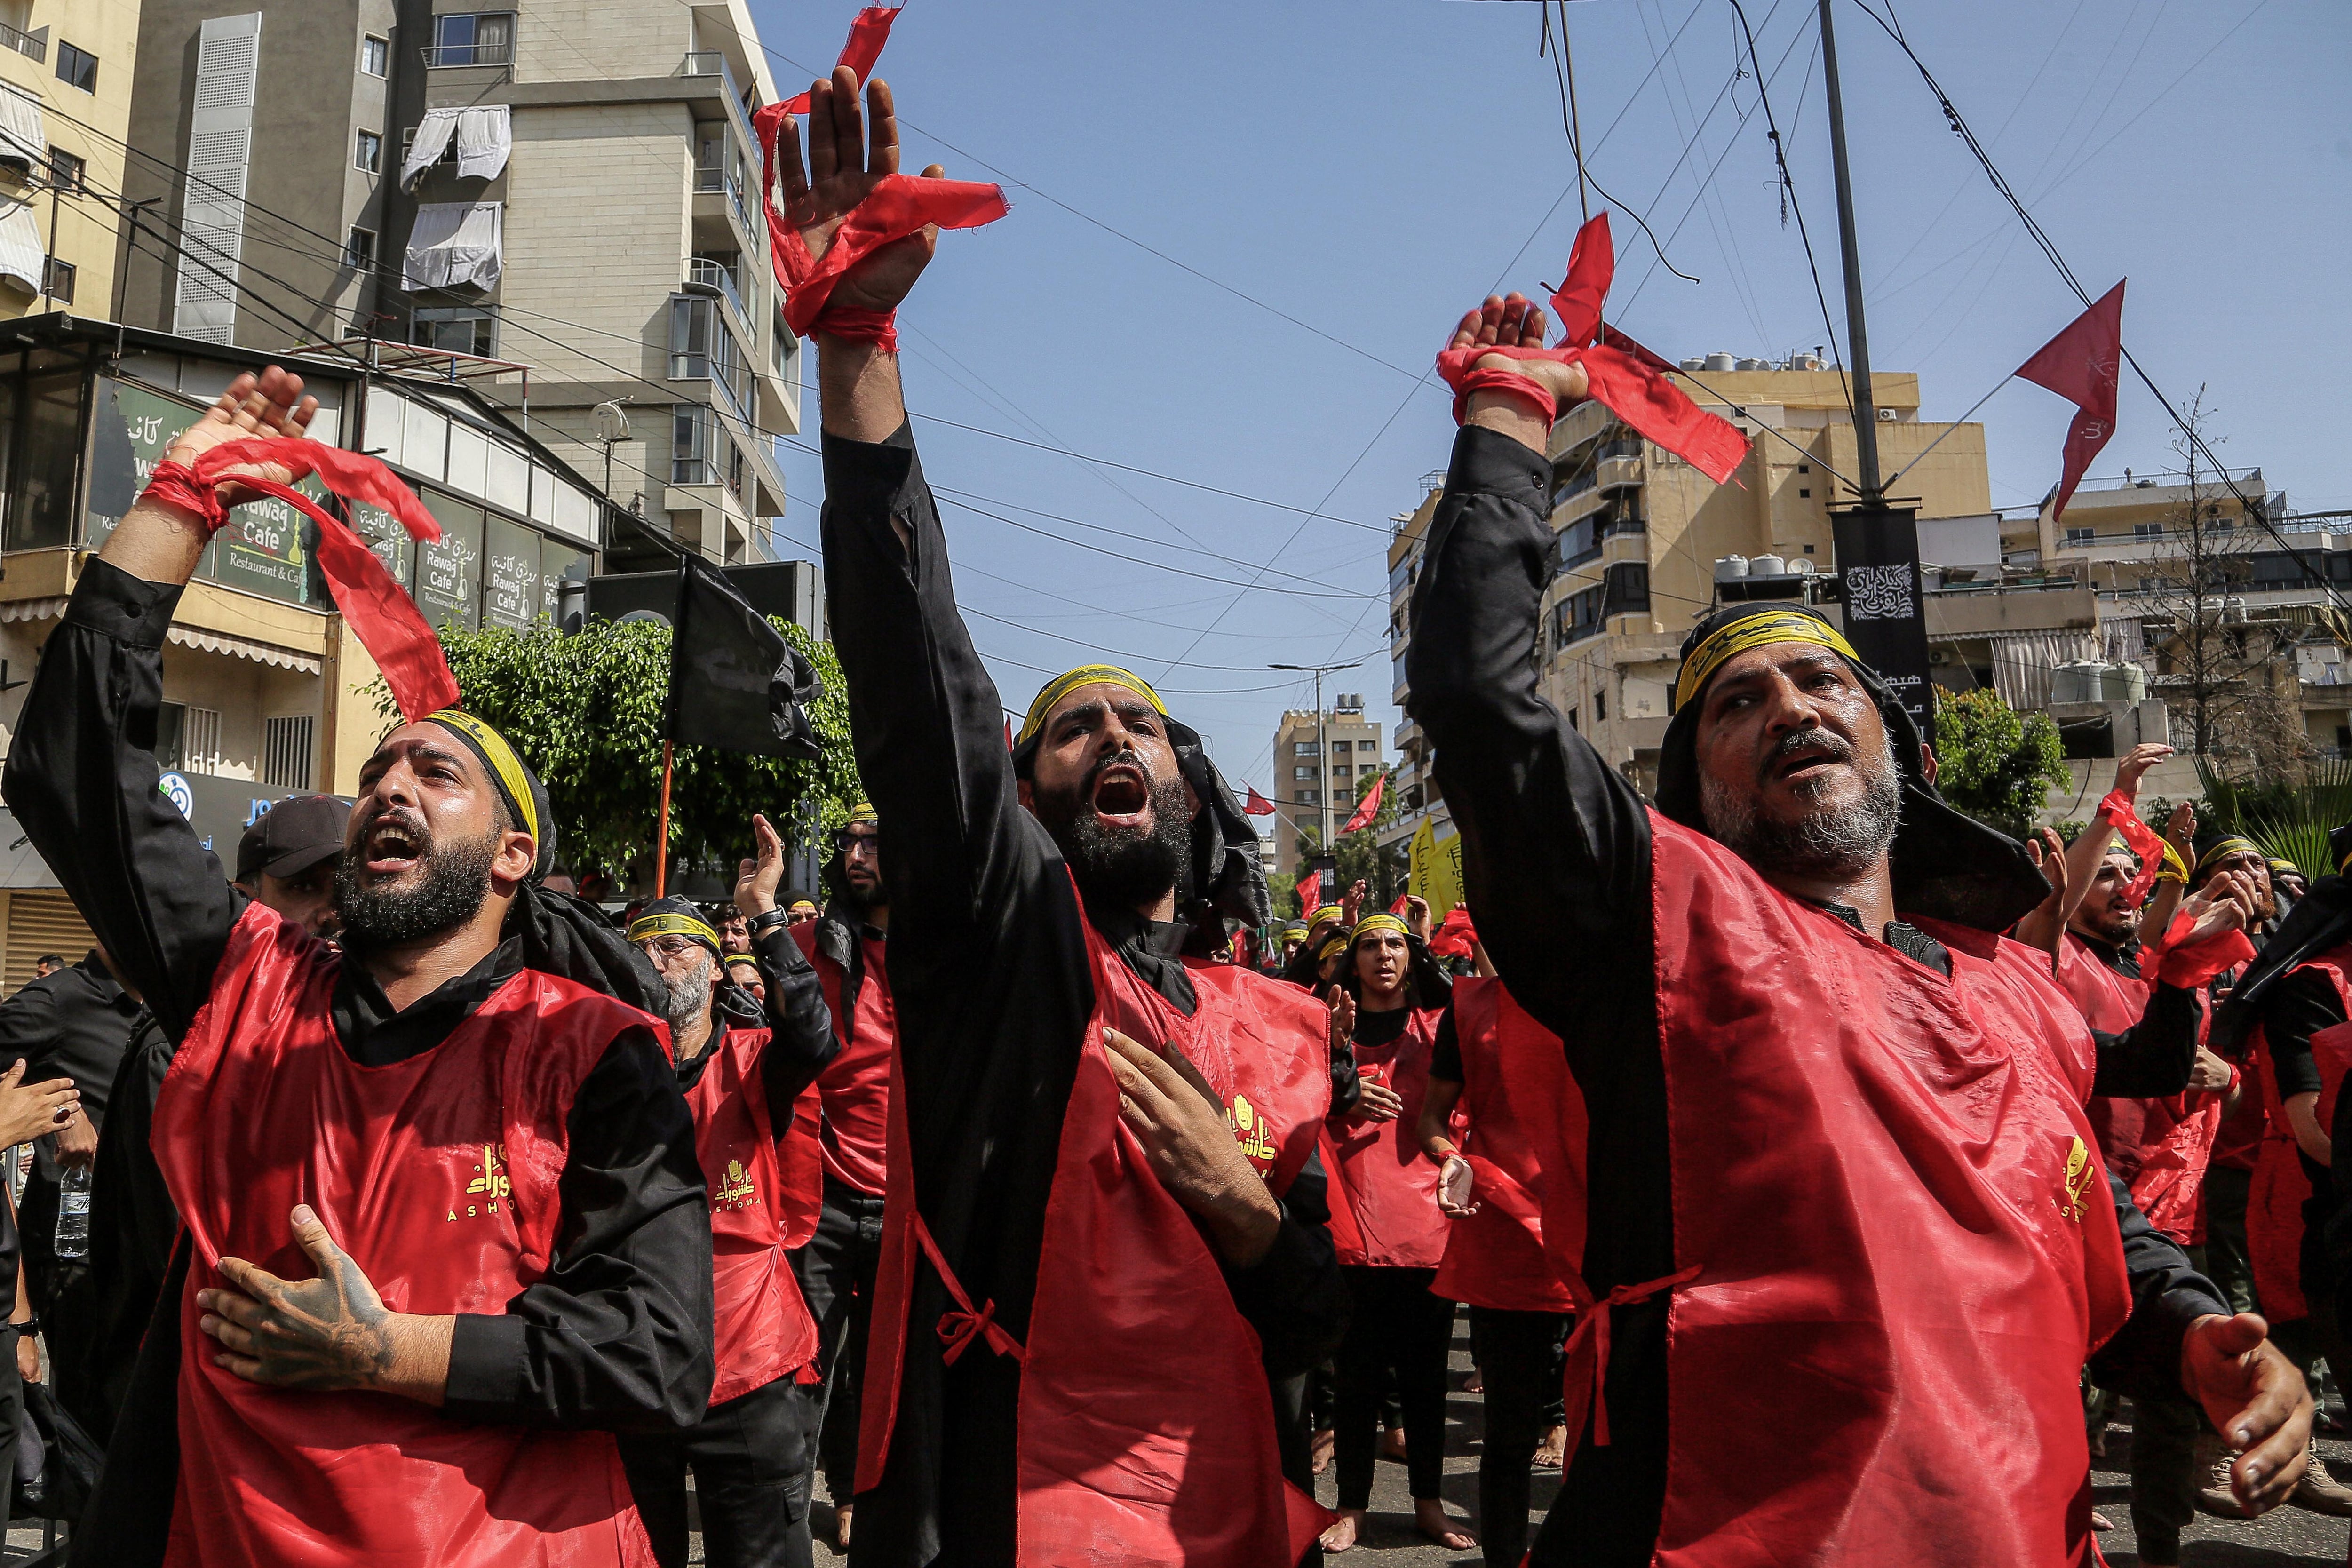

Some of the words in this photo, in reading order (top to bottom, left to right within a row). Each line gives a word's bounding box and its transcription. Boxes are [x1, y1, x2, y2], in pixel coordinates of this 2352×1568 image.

[243, 521, 279, 550] Cafe
[230, 552, 276, 577] Restaurant
[278, 566, 286, 580] &
[287, 570, 303, 589] Caf
[430, 571, 452, 590] Cafe
[497, 593, 516, 610] Cafe
[447, 1199, 515, 1222] ASHO
[709, 1198, 761, 1214] SHOURA
